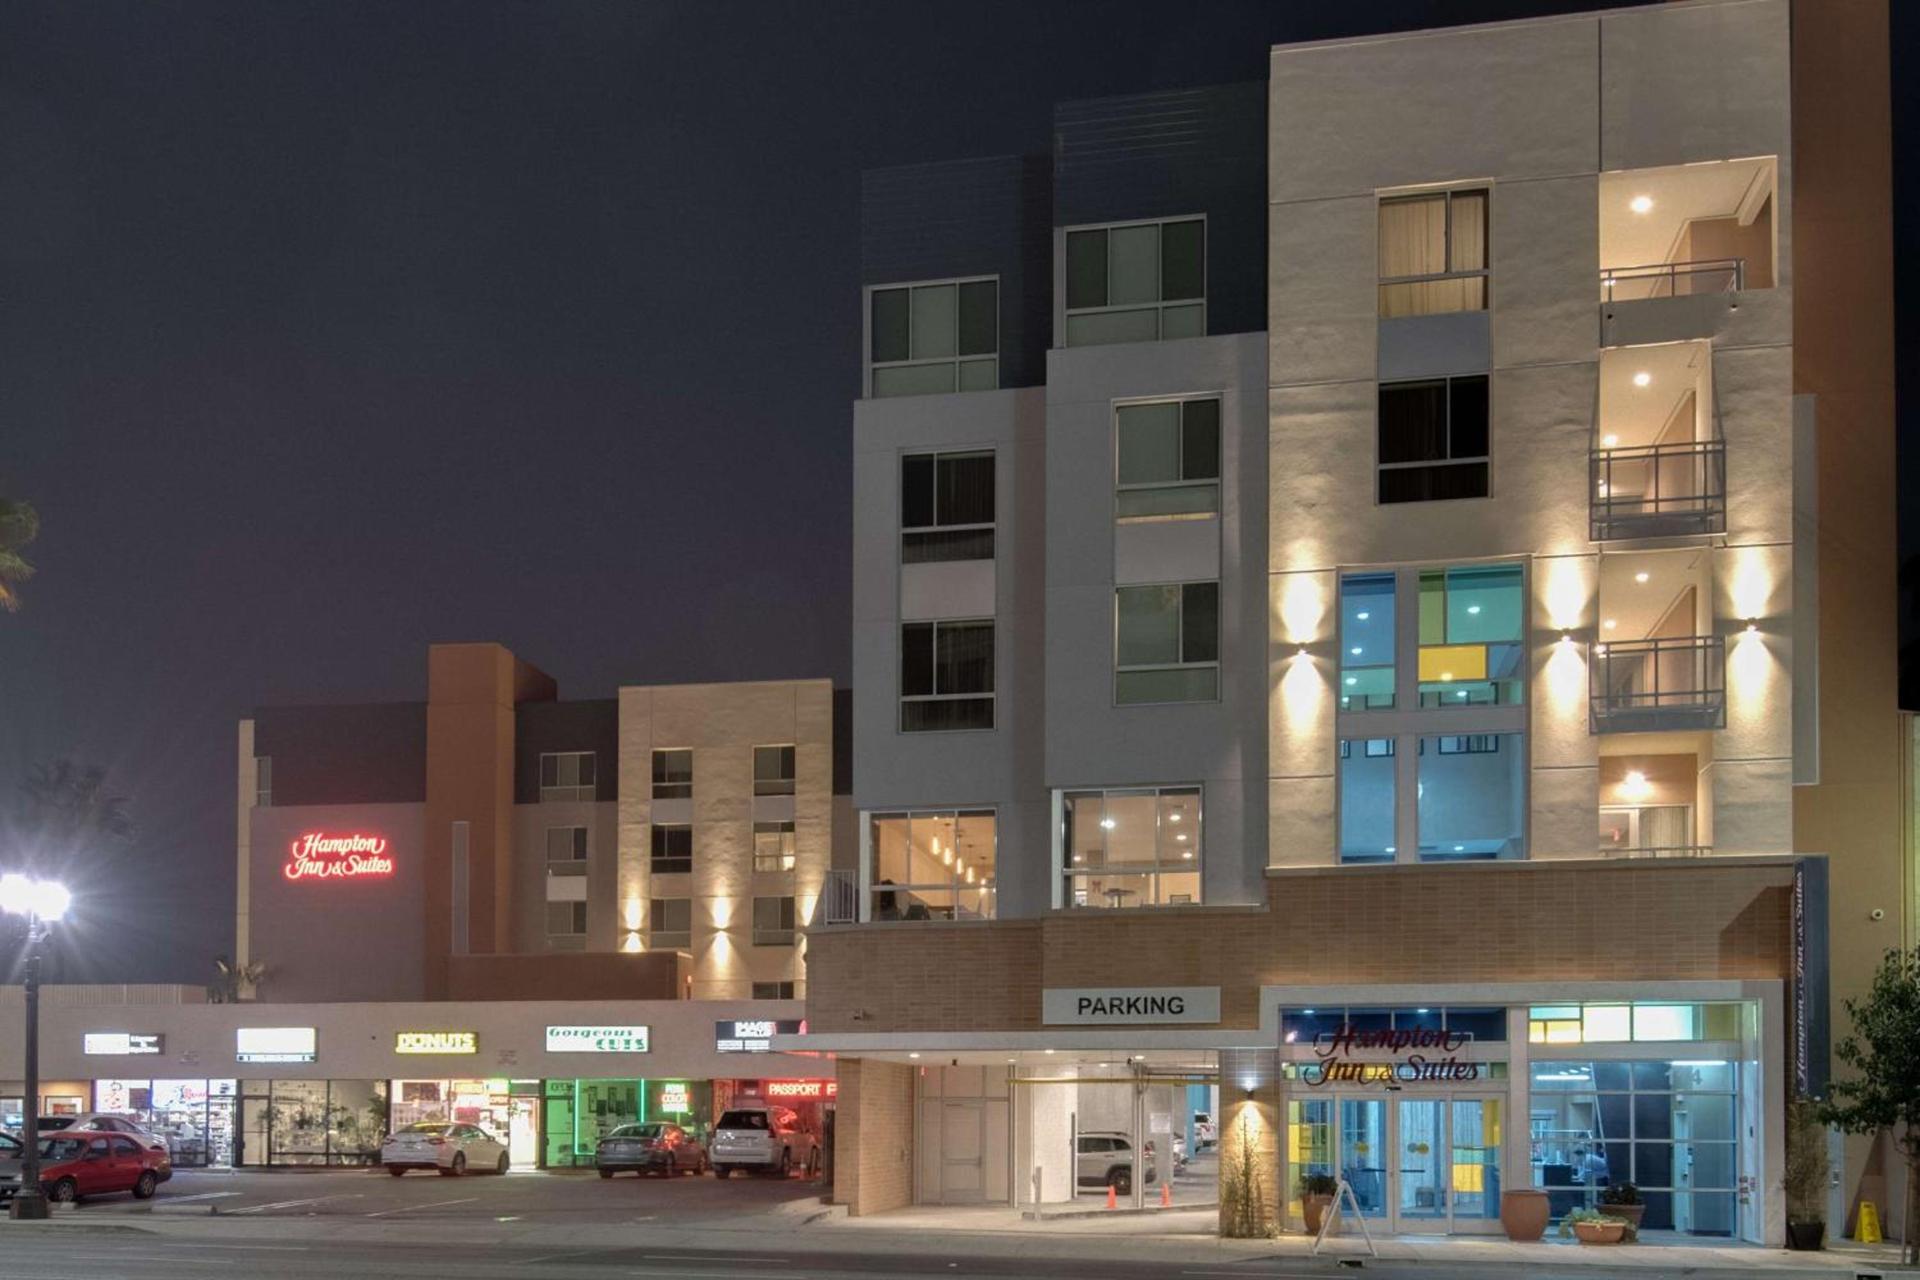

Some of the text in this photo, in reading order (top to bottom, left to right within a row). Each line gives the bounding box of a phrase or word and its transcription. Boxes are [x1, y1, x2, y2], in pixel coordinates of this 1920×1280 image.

[292, 832, 385, 859] Hampton
[285, 855, 392, 879] Inn & Suites
[1078, 996, 1184, 1015] PARKING
[397, 1033, 475, 1048] DONUTS
[548, 1028, 633, 1038] Gorgeous
[1312, 1023, 1464, 1057] Hampton
[1795, 991, 1806, 1092] Hampton
[595, 1038, 646, 1050] CUTS
[1303, 1054, 1479, 1087] Inn & Suites
[768, 1083, 821, 1096] PASSPORT
